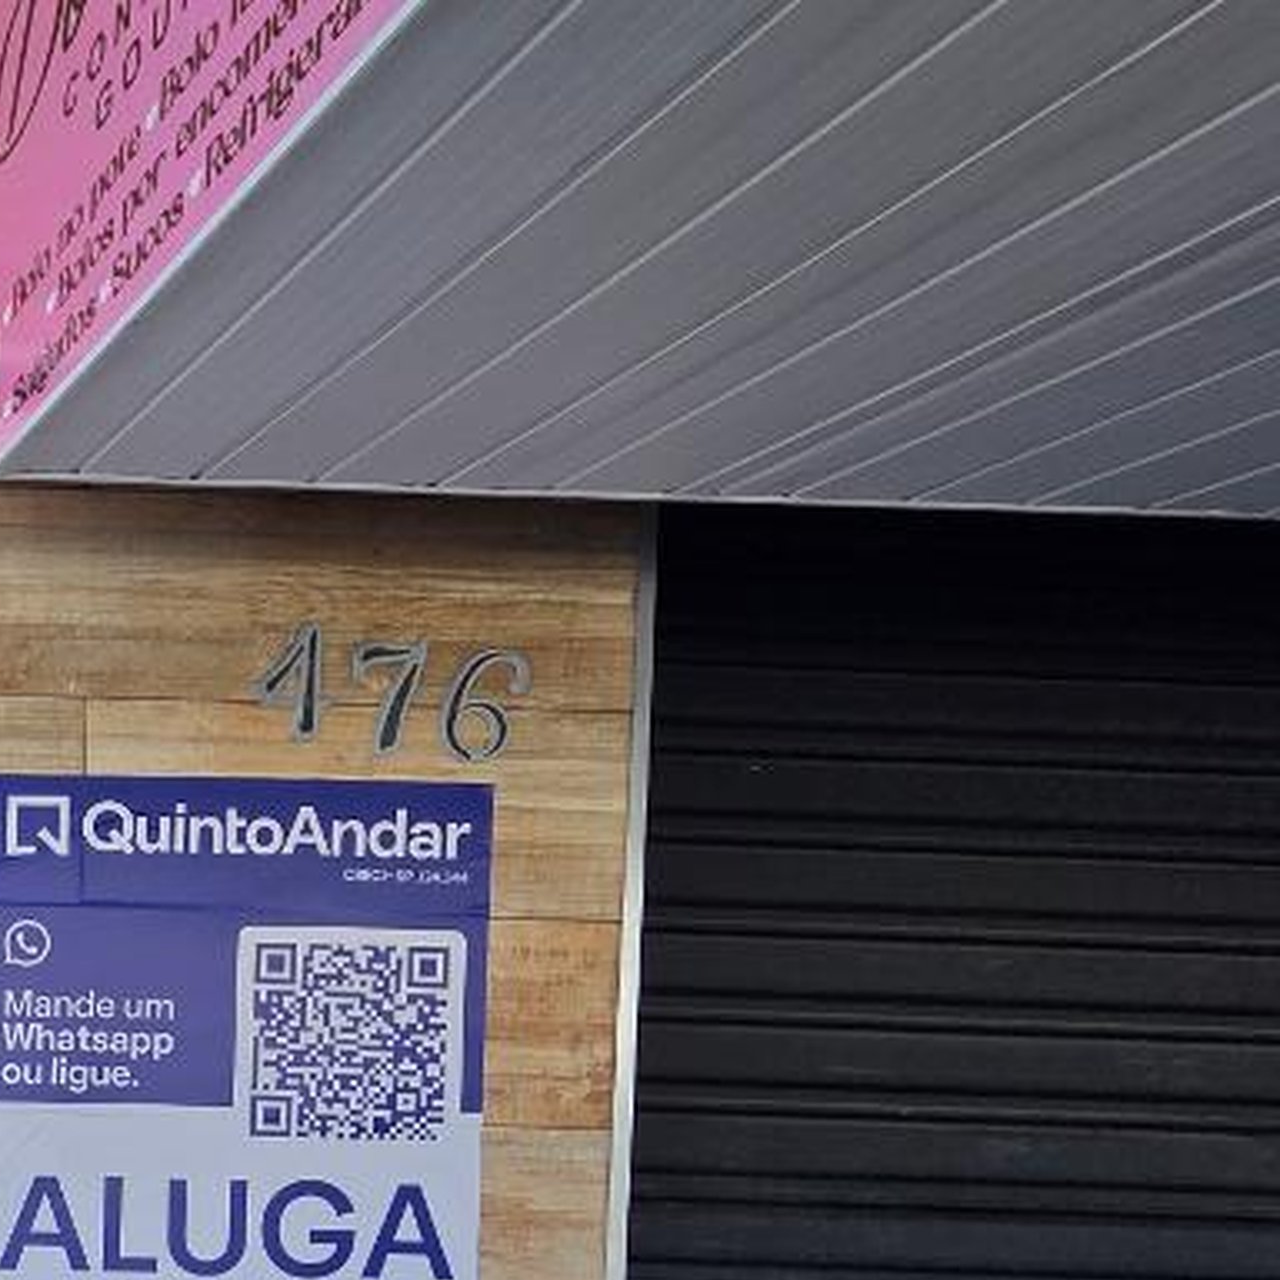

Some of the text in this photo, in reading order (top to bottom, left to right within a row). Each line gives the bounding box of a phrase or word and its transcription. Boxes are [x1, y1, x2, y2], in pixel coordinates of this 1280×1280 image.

[157, 21, 220, 121] Bolo
[121, 150, 167, 237] por
[111, 191, 185, 297] Sucos
[81, 798, 472, 861] QuintoAndar
[2, 989, 176, 1021] Mande um
[1, 1022, 176, 1060] Whatsapp
[1, 1058, 141, 1093] ou ligue.
